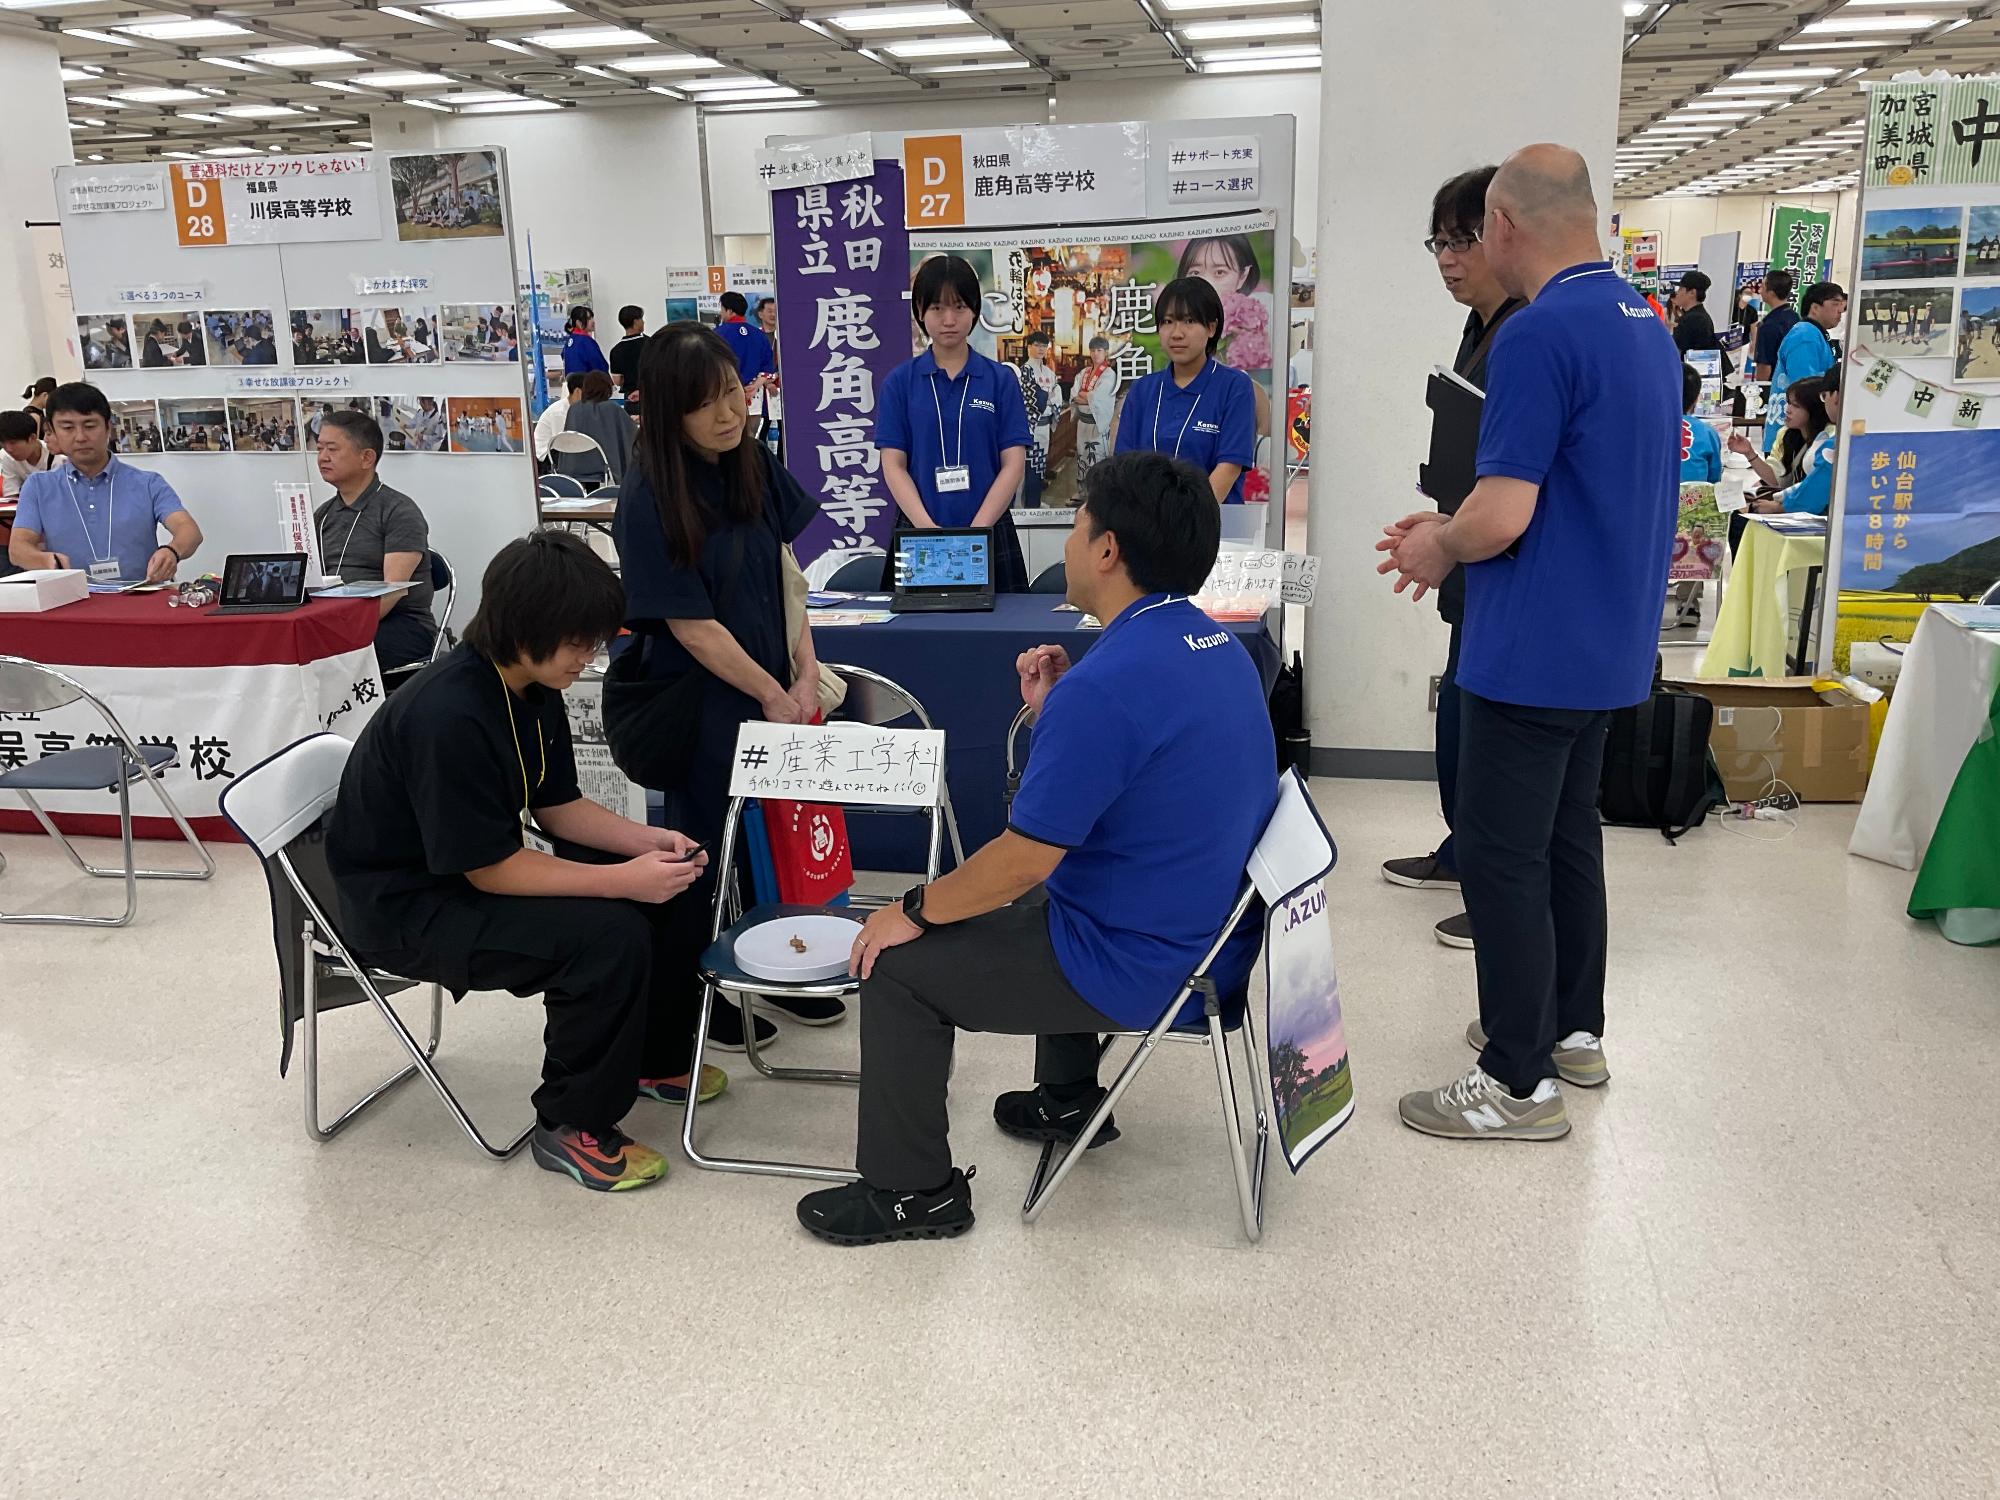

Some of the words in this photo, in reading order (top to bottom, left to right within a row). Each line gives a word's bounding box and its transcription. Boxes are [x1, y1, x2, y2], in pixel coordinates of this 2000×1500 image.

[1874, 93, 1908, 171] 加美町
[1906, 90, 1937, 178] 宮城県
[972, 153, 1012, 169] 秋田県
[1171, 148, 1254, 165] #サポート充実
[923, 157, 946, 187] D
[974, 169, 1096, 197] 鹿角高等学校
[187, 182, 207, 208] D
[246, 180, 279, 194] 福島県
[1172, 178, 1255, 195] #コース選択
[250, 198, 354, 220] 川俣高等学校
[920, 193, 951, 217] 27
[187, 215, 215, 237] 28
[796, 185, 837, 276] 県立
[839, 184, 885, 273] 秋田
[1215, 226, 1241, 234] KAZUNO
[1244, 222, 1270, 230] KAZUNO
[1618, 302, 1655, 317] Kazuno
[1914, 386, 1935, 409] 中
[1958, 398, 1982, 421] 新
[1863, 451, 1891, 572] 歩いて8時間
[1893, 450, 1917, 550] 仙台駅から
[1183, 631, 1229, 651] Kazuno
[740, 731, 940, 783] #産業工学科
